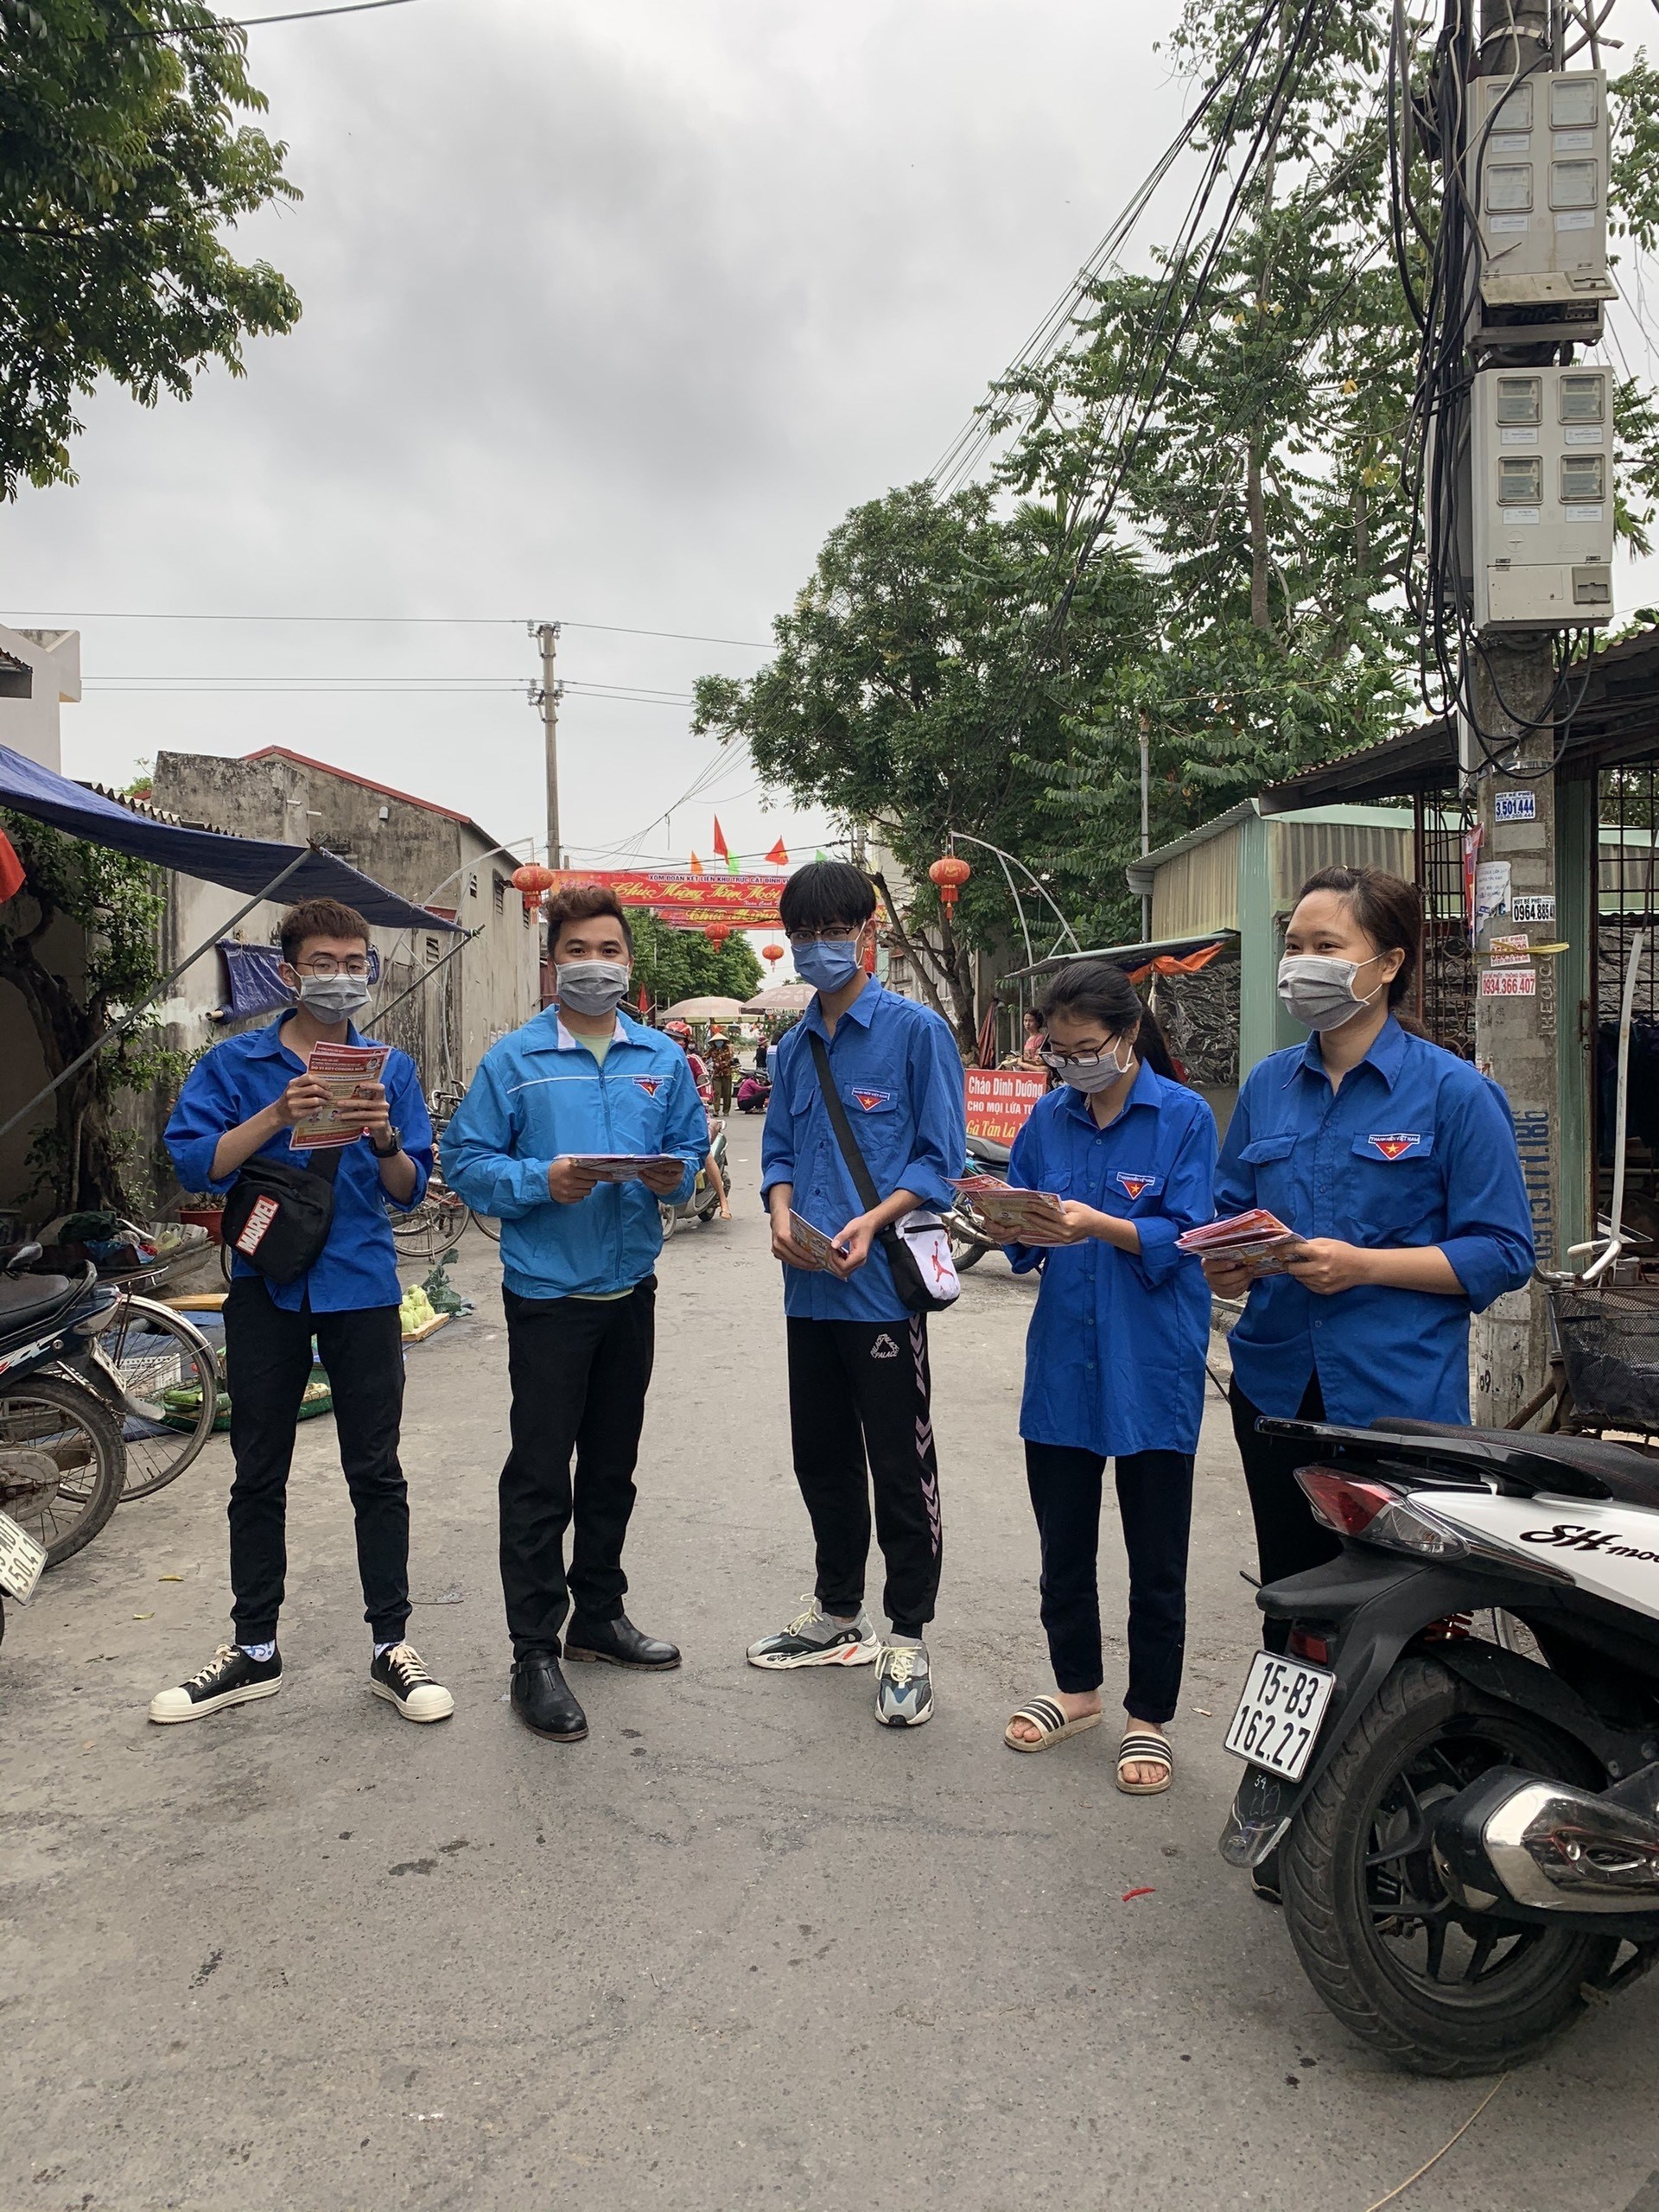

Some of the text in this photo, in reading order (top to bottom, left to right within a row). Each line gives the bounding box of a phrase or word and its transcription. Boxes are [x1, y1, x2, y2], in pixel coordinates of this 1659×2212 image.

[1496, 799, 1535, 816] 3.501.444
[610, 881, 782, 901] Chúc Mừng Năm Mới
[1483, 977, 1535, 995] 0934.366.407
[968, 1076, 1044, 1099] Cháo Dinh Dưỡng
[967, 1100, 985, 1112] CHO
[986, 1102, 1003, 1115] MỌI
[1005, 1101, 1021, 1115] LỨA
[966, 1118, 980, 1135] Gà
[1002, 1121, 1016, 1138] Lá
[237, 1198, 280, 1255] MARVEL
[1519, 1524, 1623, 1551] SH
[1256, 1662, 1319, 1719] 15-B3
[1233, 1705, 1311, 1770] 162.27
